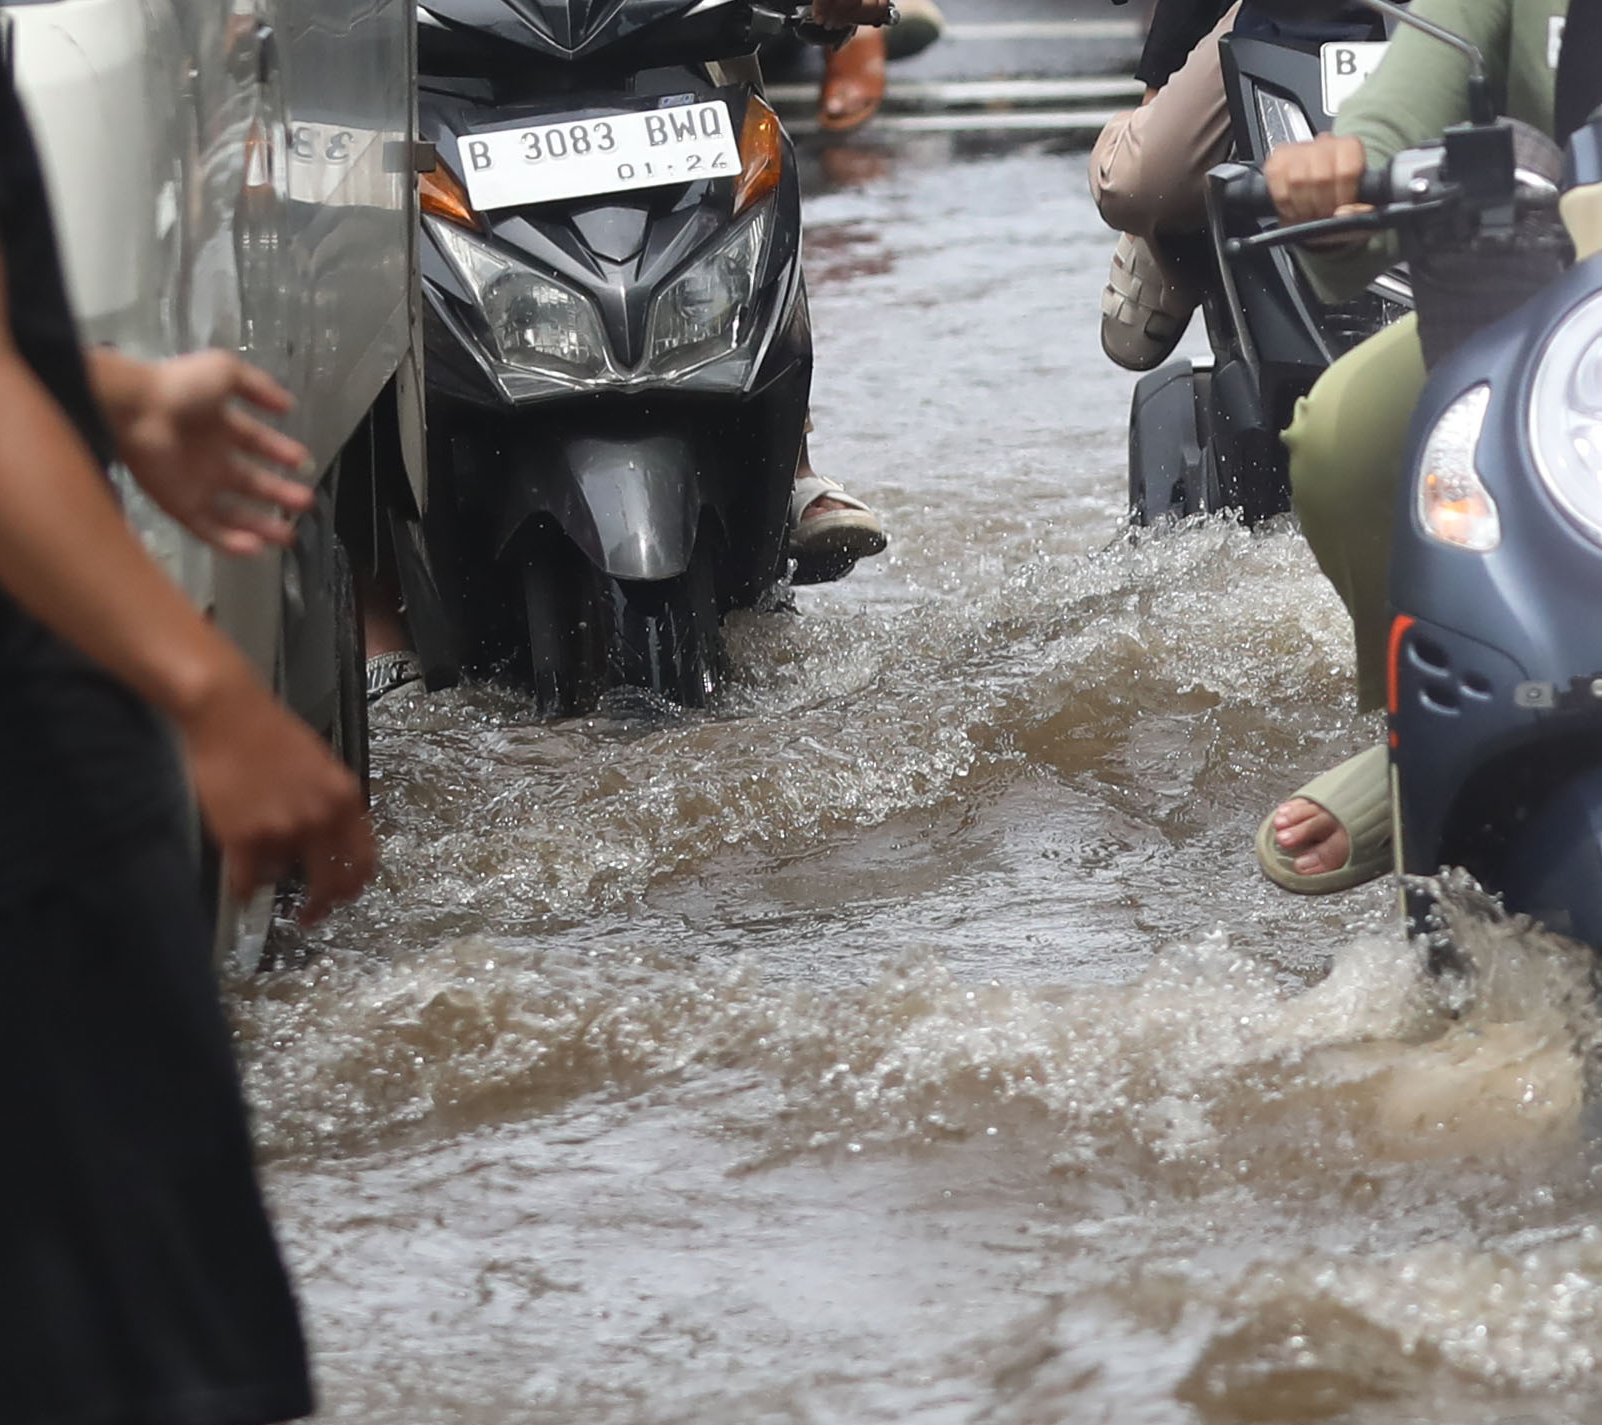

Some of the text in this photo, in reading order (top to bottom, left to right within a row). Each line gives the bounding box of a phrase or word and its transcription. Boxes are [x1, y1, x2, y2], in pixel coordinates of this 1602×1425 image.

[1335, 48, 1358, 76] B
[469, 107, 722, 172] B 3083 BWQ
